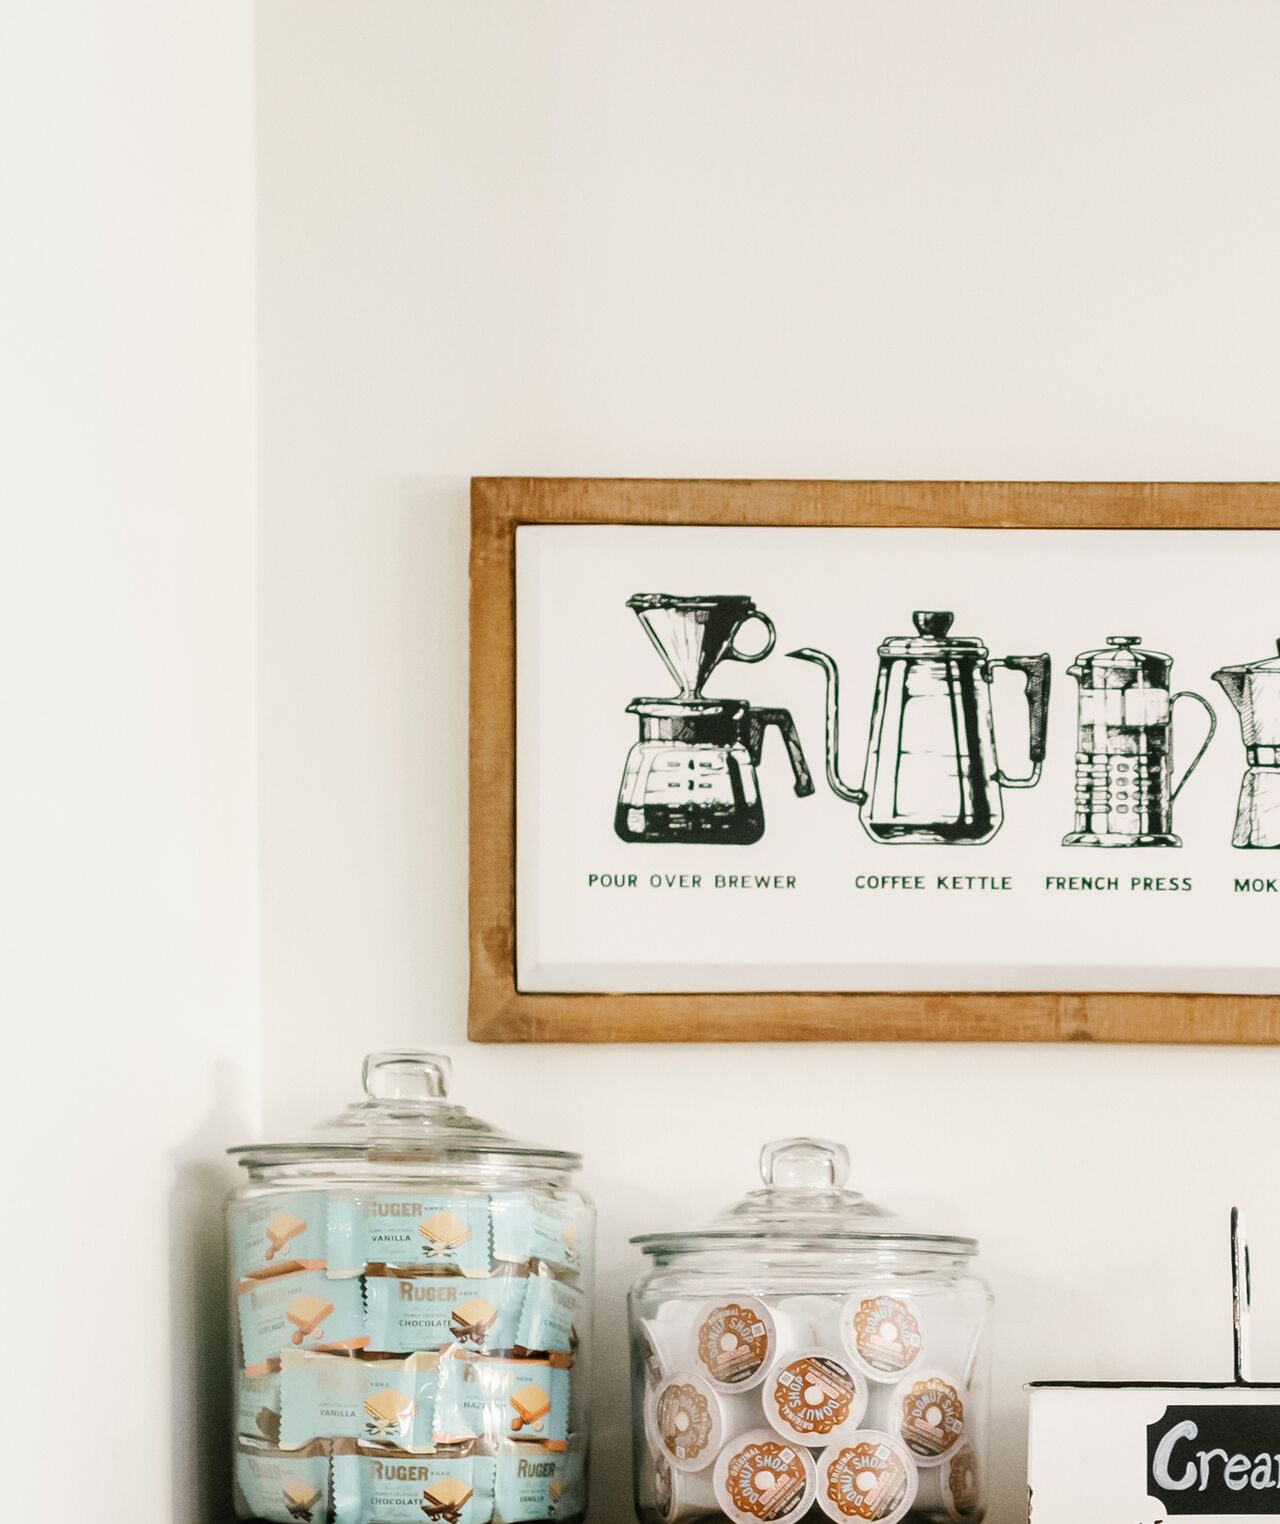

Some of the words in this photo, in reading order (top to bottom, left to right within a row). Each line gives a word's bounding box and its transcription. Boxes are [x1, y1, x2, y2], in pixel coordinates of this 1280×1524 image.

[588, 873, 638, 888] POUR
[649, 874, 702, 889] OVER
[714, 874, 797, 889] BREWER
[854, 875, 926, 890] COFFEE
[937, 876, 1012, 890] KETTLE
[1045, 876, 1119, 891] FRENCH
[1131, 876, 1192, 892] PRESS
[363, 1201, 423, 1217] RUGER
[371, 1234, 412, 1242] VANILLA
[398, 1281, 457, 1301] RUGER
[398, 1319, 452, 1328] CHOCOLATE
[788, 1376, 803, 1407] SHOP
[319, 1409, 356, 1417] VANILLA
[800, 1399, 840, 1421] DONUT
[912, 1391, 940, 1418] DONUT
[371, 1461, 429, 1481] RUGER
[517, 1459, 556, 1477] RUGER
[730, 1447, 760, 1477] ORIGINAL
[831, 1450, 856, 1483] ORIGINAL
[739, 1462, 759, 1504] DONUT
[754, 1455, 788, 1472] SHOP
[840, 1466, 863, 1507] DONUT
[853, 1455, 887, 1470] SHOP
[370, 1498, 423, 1506] CHOCOLATE
